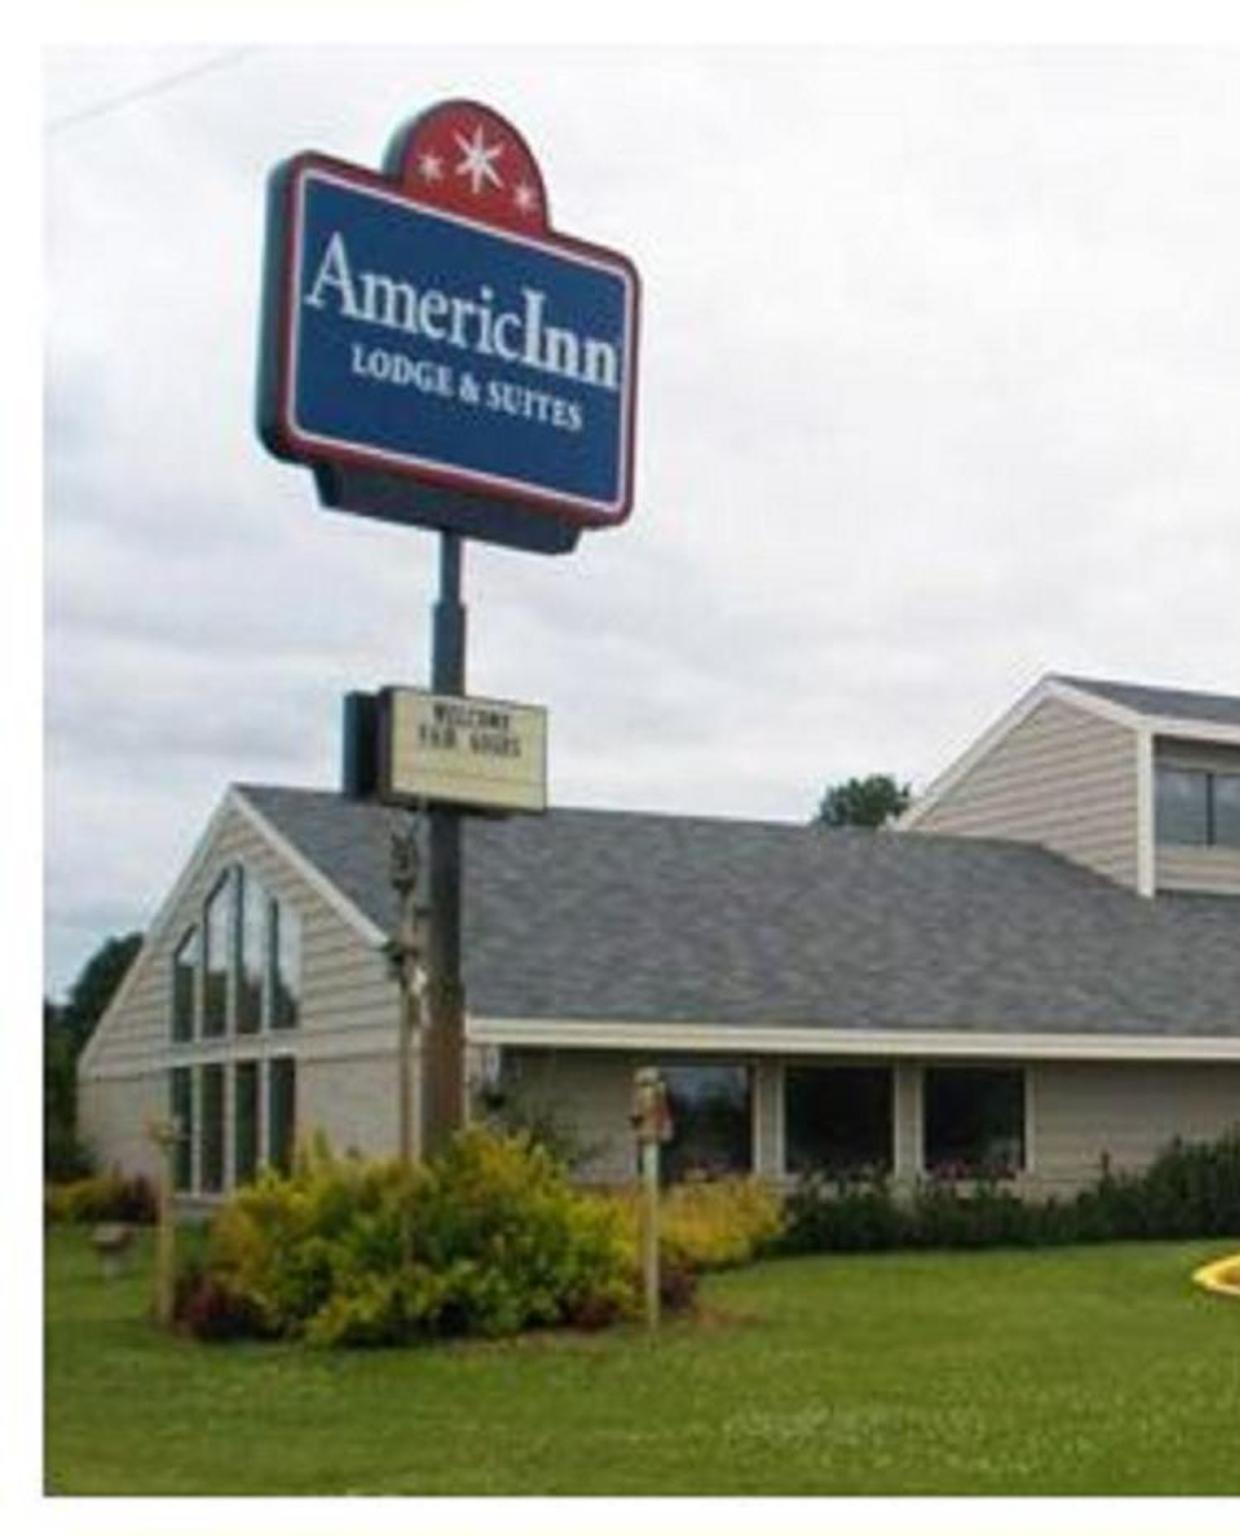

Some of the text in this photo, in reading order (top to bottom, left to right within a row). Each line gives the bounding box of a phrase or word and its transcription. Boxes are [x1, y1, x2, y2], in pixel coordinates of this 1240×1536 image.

[305, 231, 619, 390] AmericInn
[351, 344, 584, 431] LODGE & SUITES
